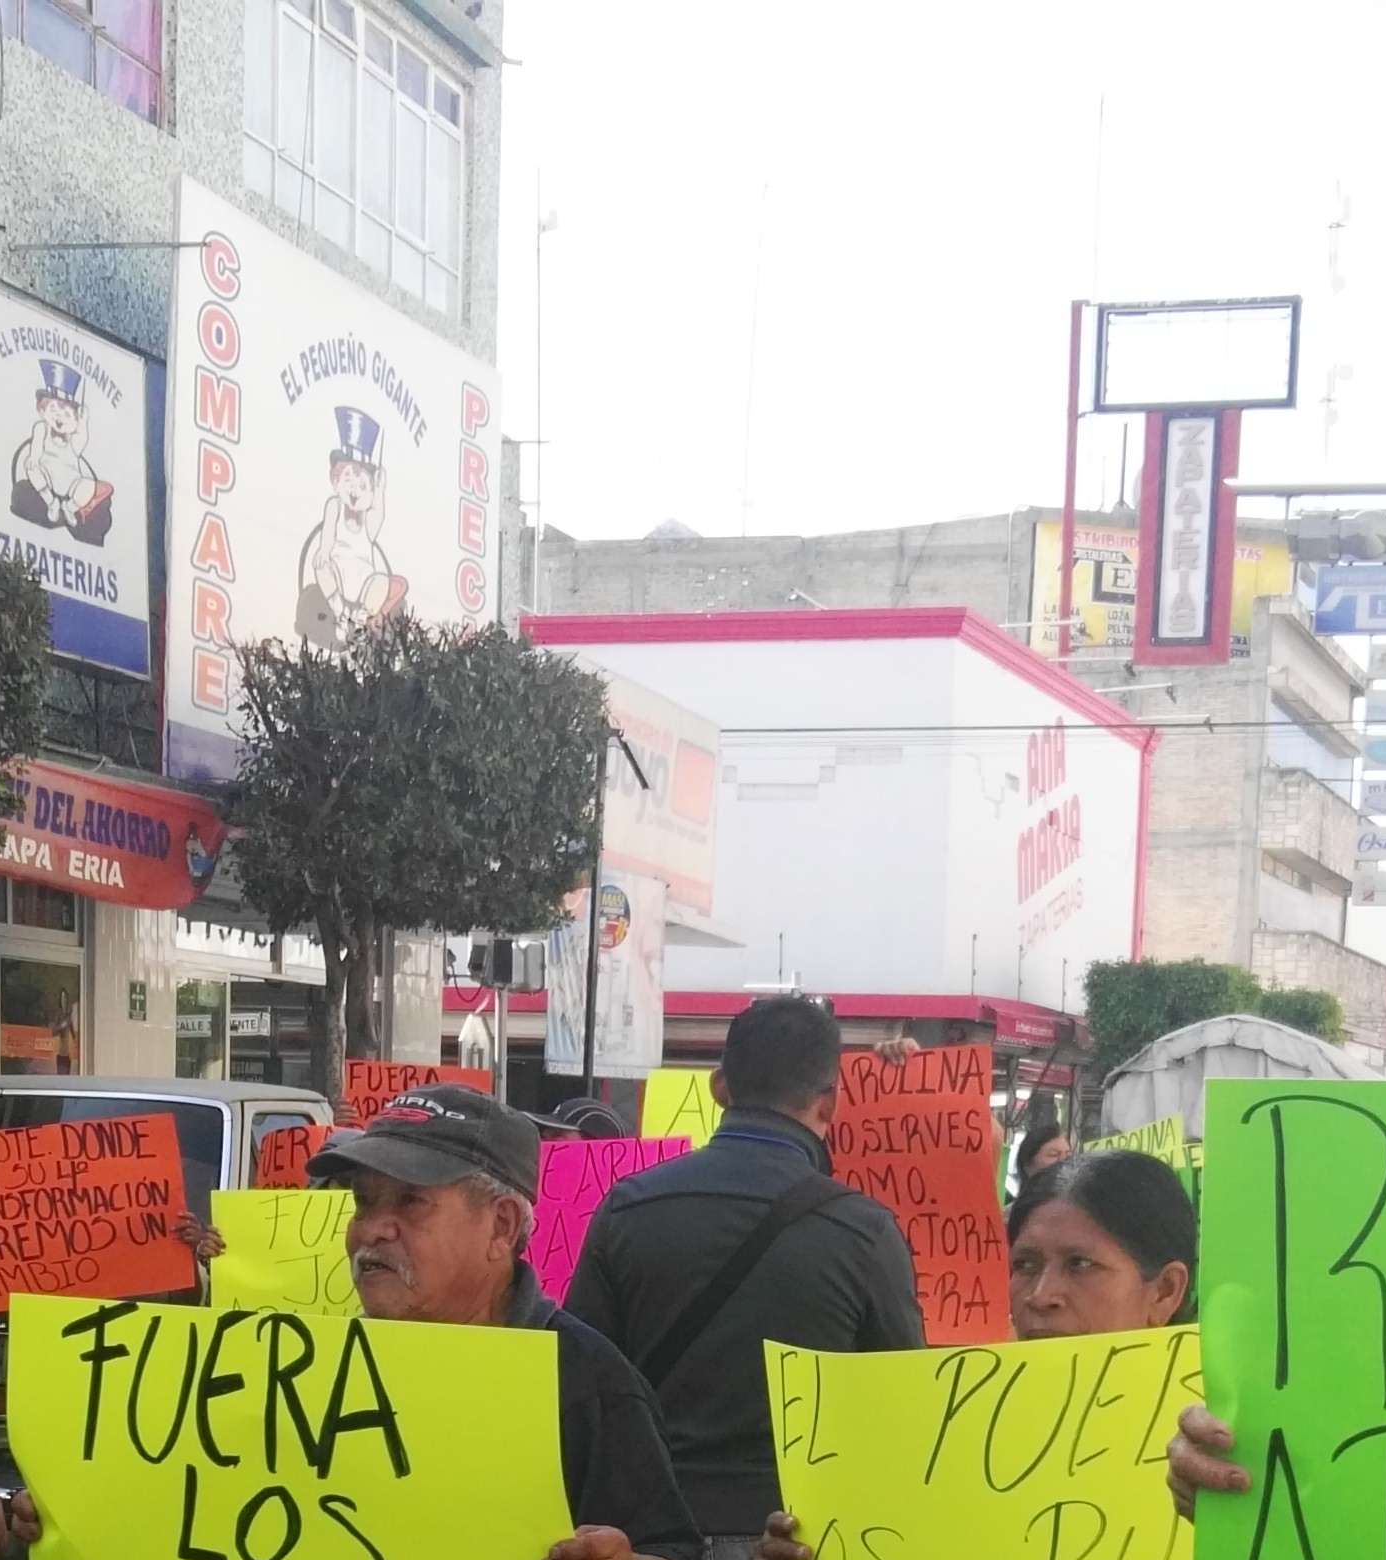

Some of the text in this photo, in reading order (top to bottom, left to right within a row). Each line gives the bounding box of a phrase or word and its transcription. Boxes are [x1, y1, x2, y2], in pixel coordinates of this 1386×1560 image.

[12, 326, 69, 360] PEQUEÑO
[72, 345, 122, 408] GIGANTE
[280, 331, 427, 449] EL PEQUEÑO GIGANTE
[455, 380, 489, 645] PREC
[1169, 424, 1206, 633] ZAPATERIAS
[1026, 714, 1066, 807] ANA
[34, 786, 77, 838] DEL
[82, 799, 171, 860] AHORRO
[1017, 793, 1082, 905] MARIA
[349, 1062, 439, 1092] FUERA
[4, 1161, 46, 1190] SU
[62, 1120, 156, 1162] DONDE
[862, 1110, 984, 1157] SIRVES
[126, 1211, 169, 1246] UN
[61, 1302, 411, 1479] FUERA
[781, 1351, 838, 1465] EL
